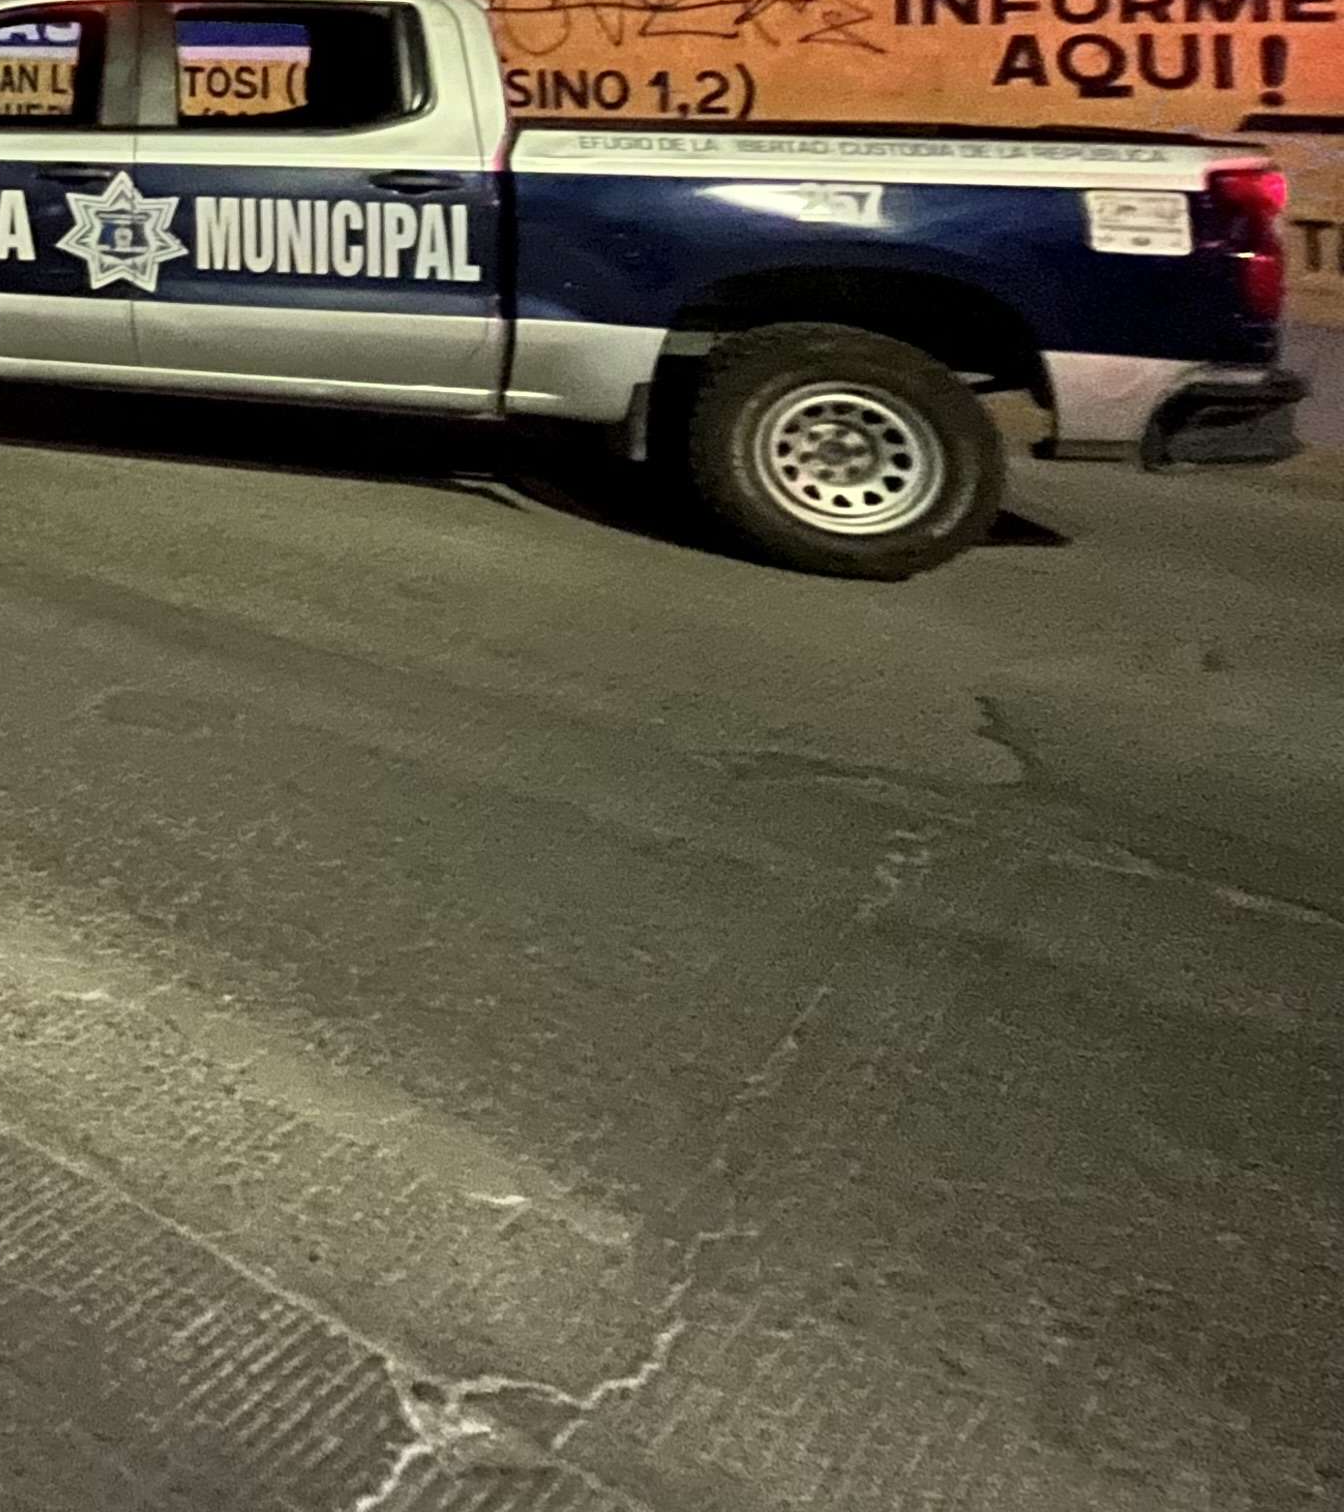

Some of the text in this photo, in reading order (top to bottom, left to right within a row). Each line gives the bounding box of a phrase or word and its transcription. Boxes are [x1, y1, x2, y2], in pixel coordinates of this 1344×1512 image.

[184, 65, 270, 100] TOSI
[503, 66, 630, 111] SINO
[648, 63, 756, 121] 1,2)
[195, 195, 482, 282] MUNICIPAL
